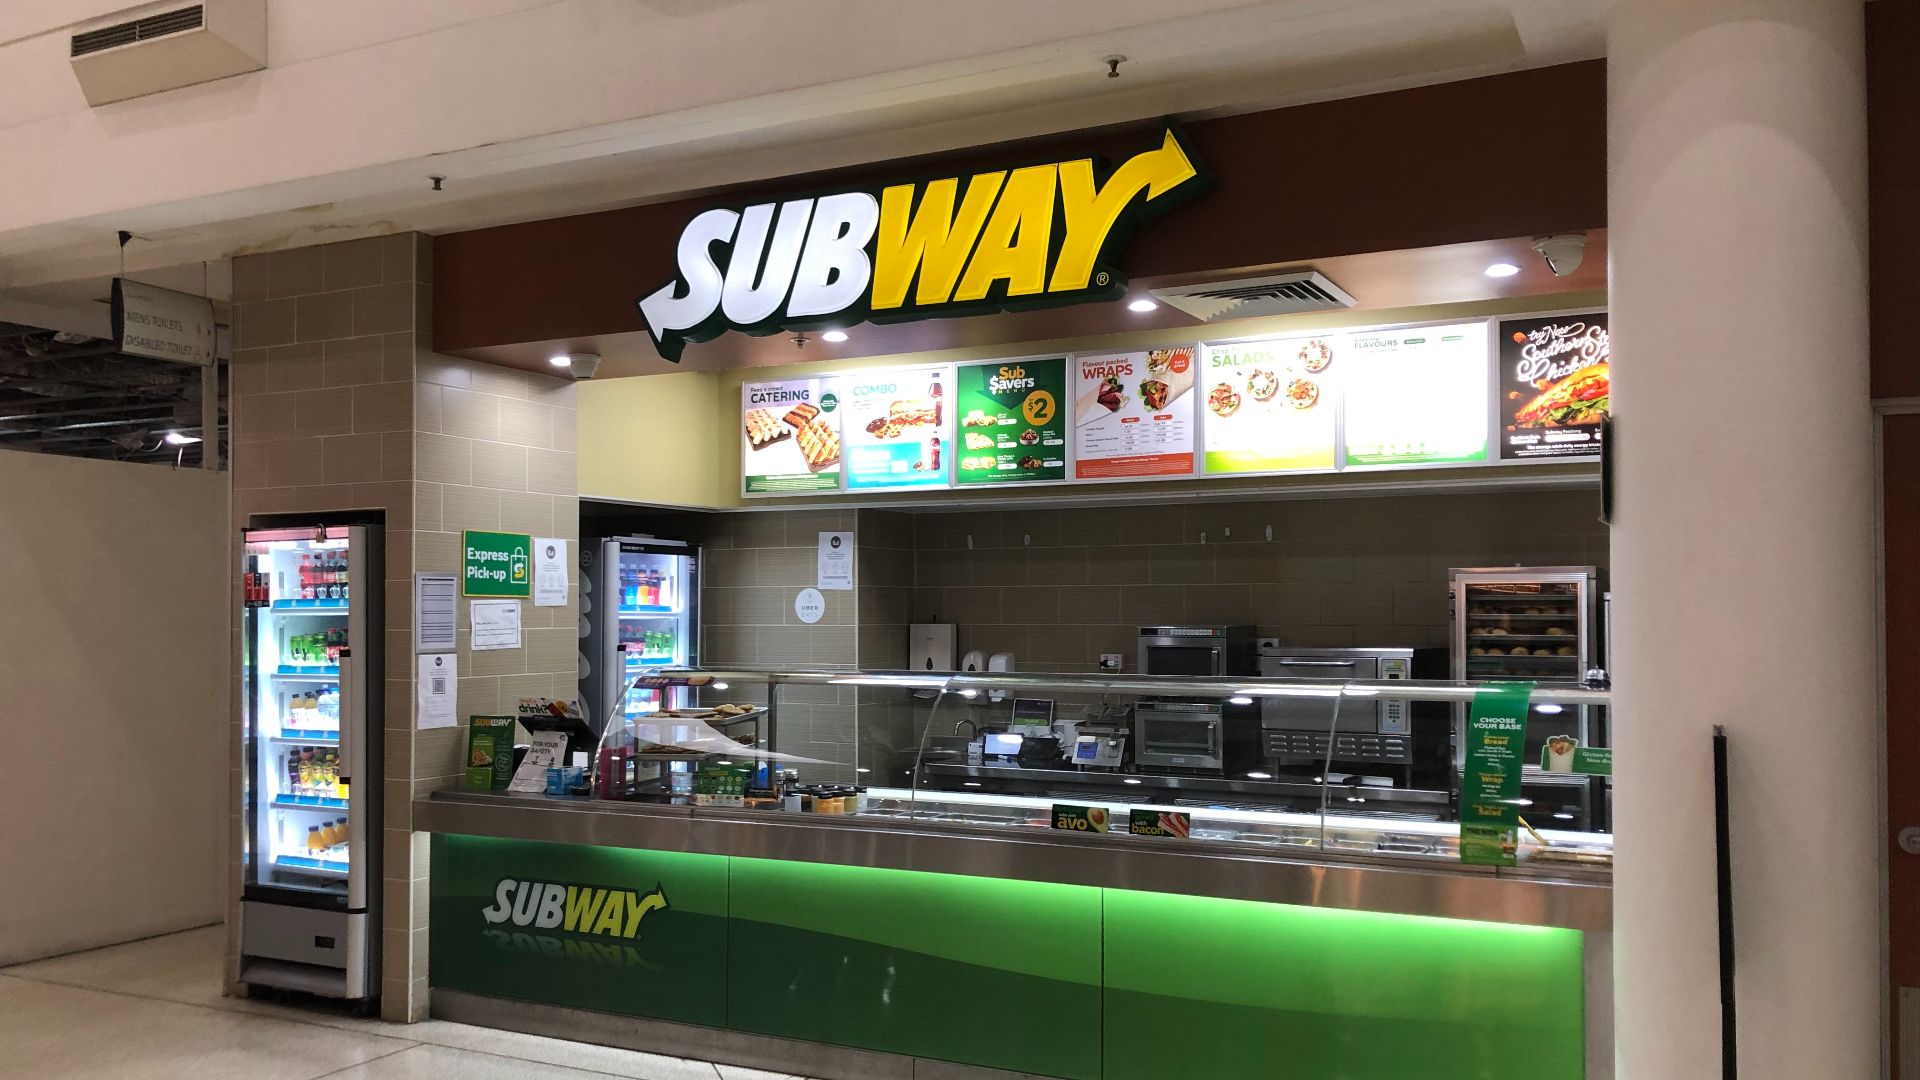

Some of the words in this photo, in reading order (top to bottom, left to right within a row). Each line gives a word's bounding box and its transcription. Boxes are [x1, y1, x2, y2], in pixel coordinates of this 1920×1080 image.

[640, 128, 1196, 341] SUBWAY
[1354, 339, 1398, 349] FLAVOURS
[1105, 357, 1128, 366] packed
[1212, 351, 1274, 367] SALADS
[1518, 337, 1591, 377] Southern
[999, 366, 1025, 380] Sub
[1082, 364, 1133, 380] WRAPS
[853, 383, 897, 396] COMBO
[751, 390, 809, 404] CATERING
[1027, 398, 1047, 418] $2
[467, 546, 509, 563] Express
[467, 566, 506, 582] Pick-up
[518, 704, 548, 714] drink?
[474, 718, 512, 727] SUBWAY
[530, 747, 551, 755] SAFETY
[1481, 775, 1504, 784] Wrap
[1057, 816, 1088, 831] avo
[1132, 822, 1164, 835] bacon
[482, 879, 667, 938] SUBWAY
